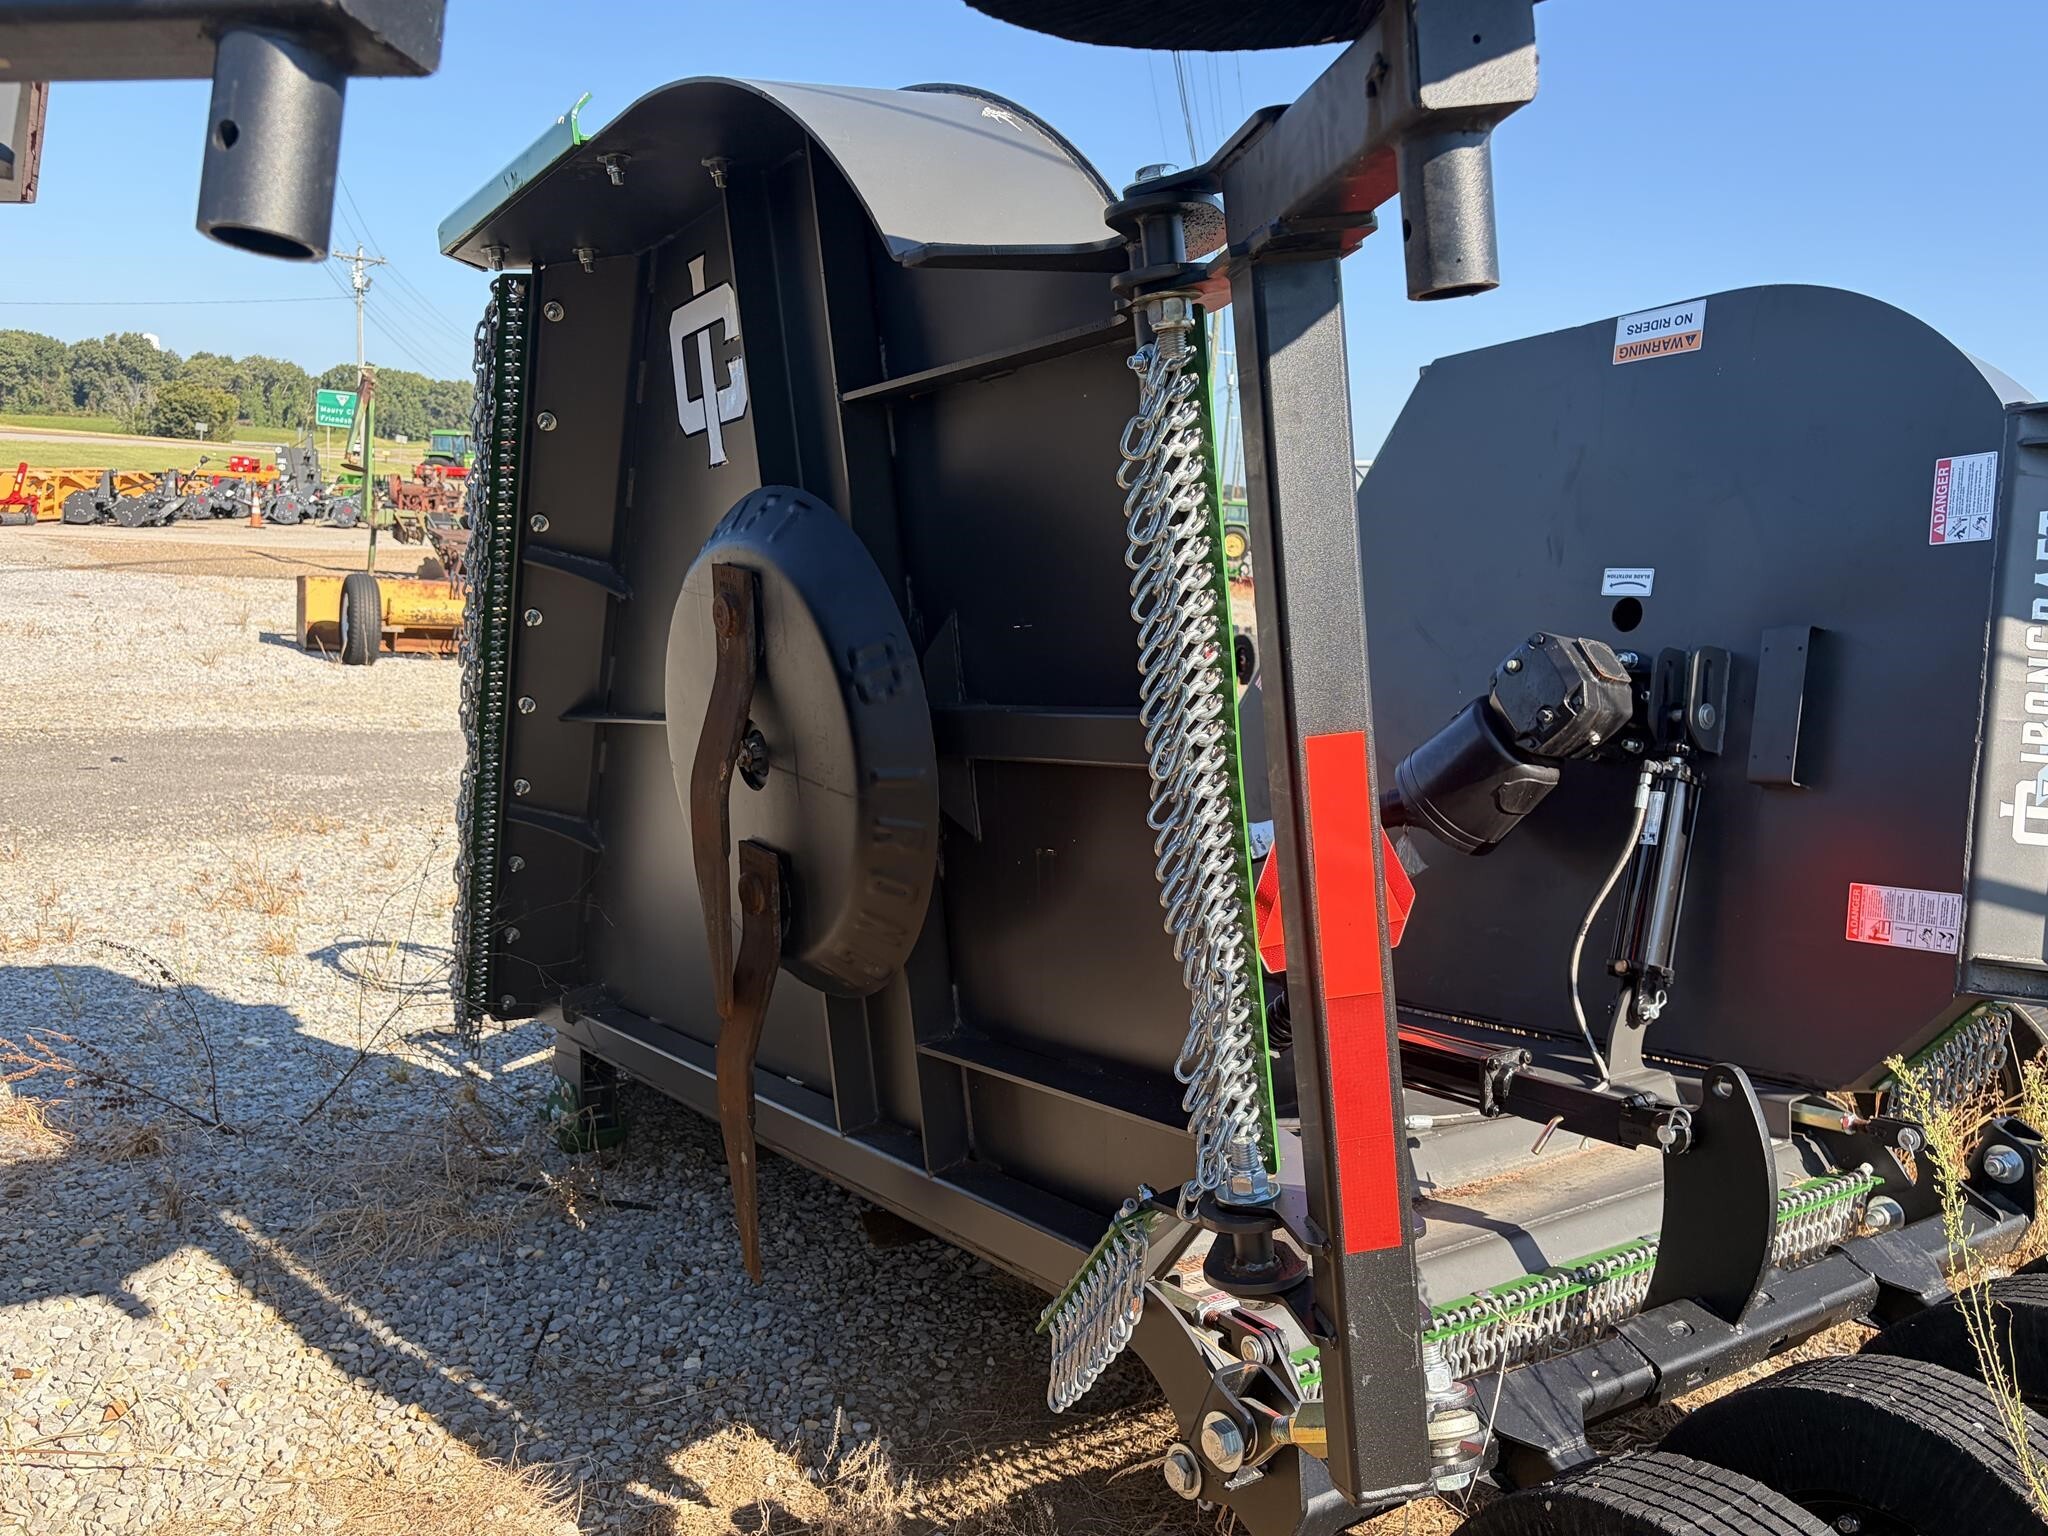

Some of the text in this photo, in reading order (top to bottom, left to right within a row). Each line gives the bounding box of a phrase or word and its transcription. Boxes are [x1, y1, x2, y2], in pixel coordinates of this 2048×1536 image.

[1626, 312, 1693, 336] NO RIDERS
[1619, 336, 1683, 358] WARNING
[320, 406, 344, 415] Maury
[320, 415, 353, 425] Friendsh
[1933, 467, 1949, 524] DANGER
[1851, 889, 1861, 927] DANGER
